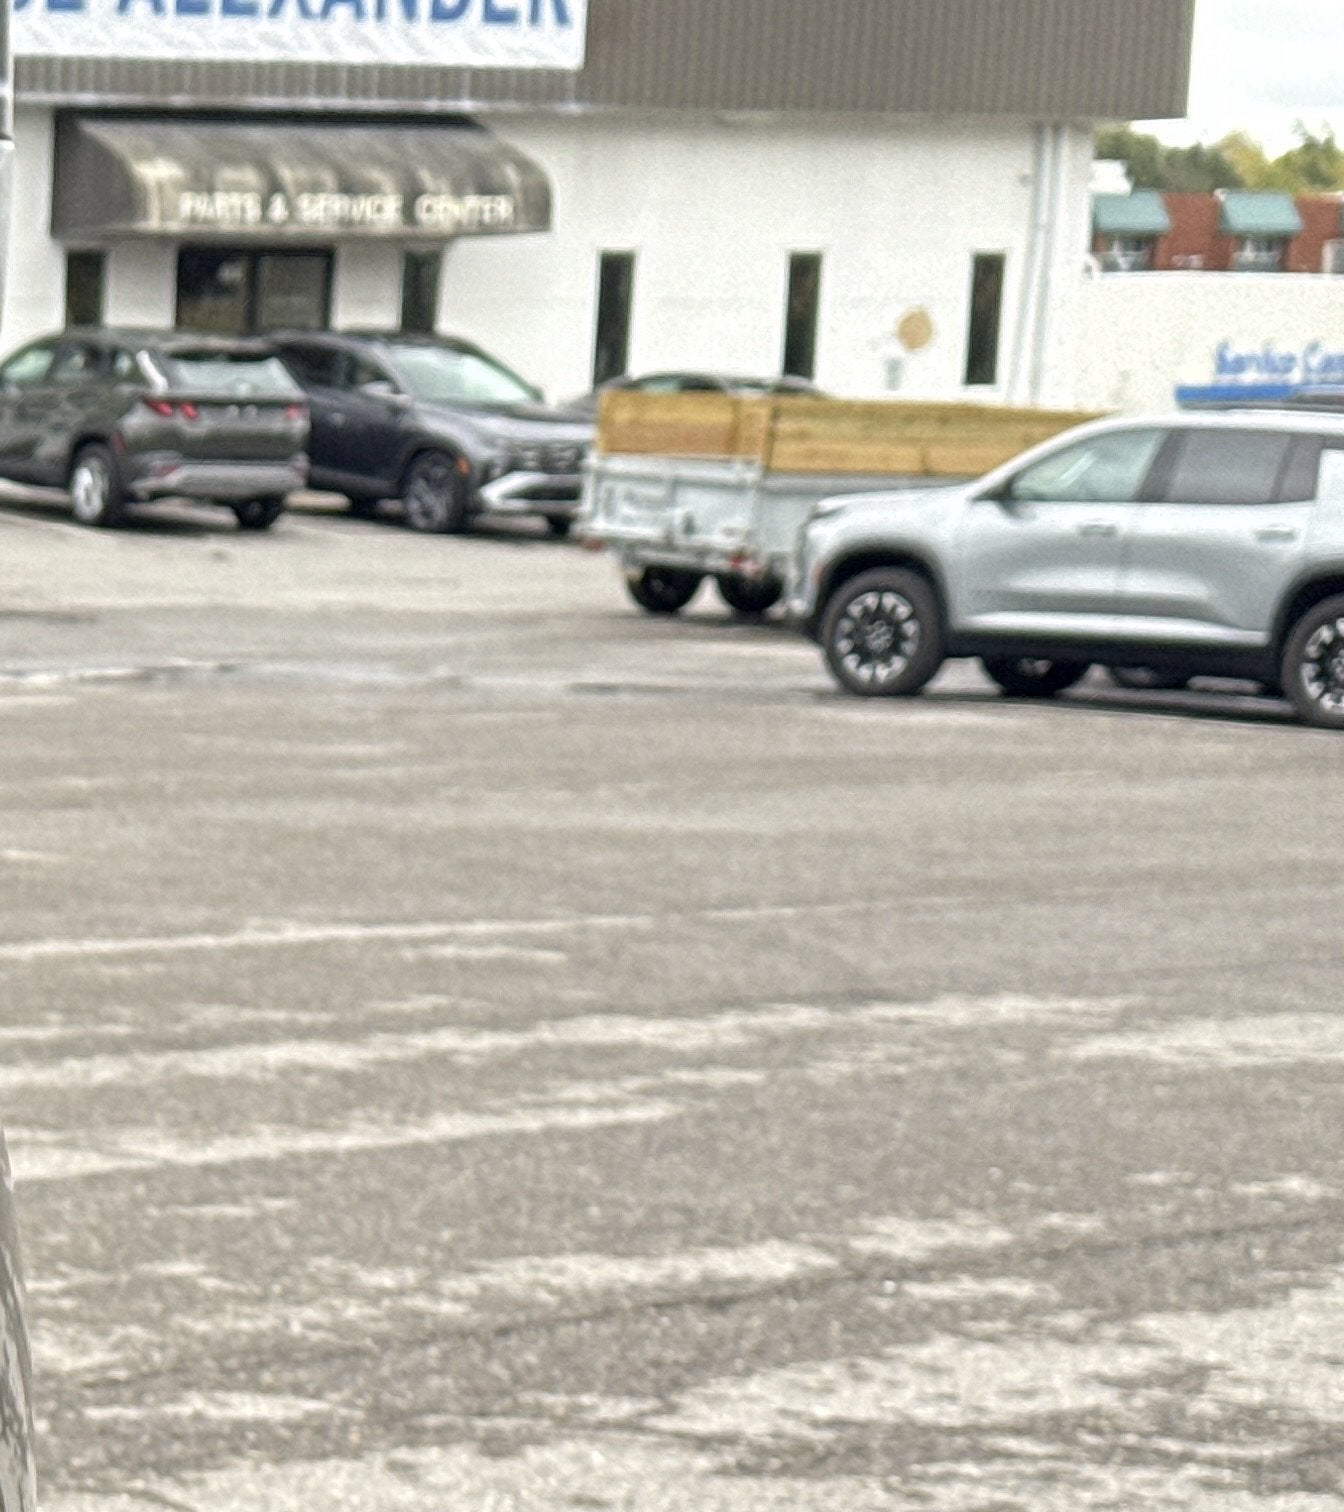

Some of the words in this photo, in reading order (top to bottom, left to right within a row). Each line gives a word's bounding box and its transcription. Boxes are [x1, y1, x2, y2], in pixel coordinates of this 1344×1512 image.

[179, 191, 262, 222] PARTS
[268, 192, 289, 223] &
[297, 193, 404, 225] SERVICE
[415, 194, 514, 227] CENTER
